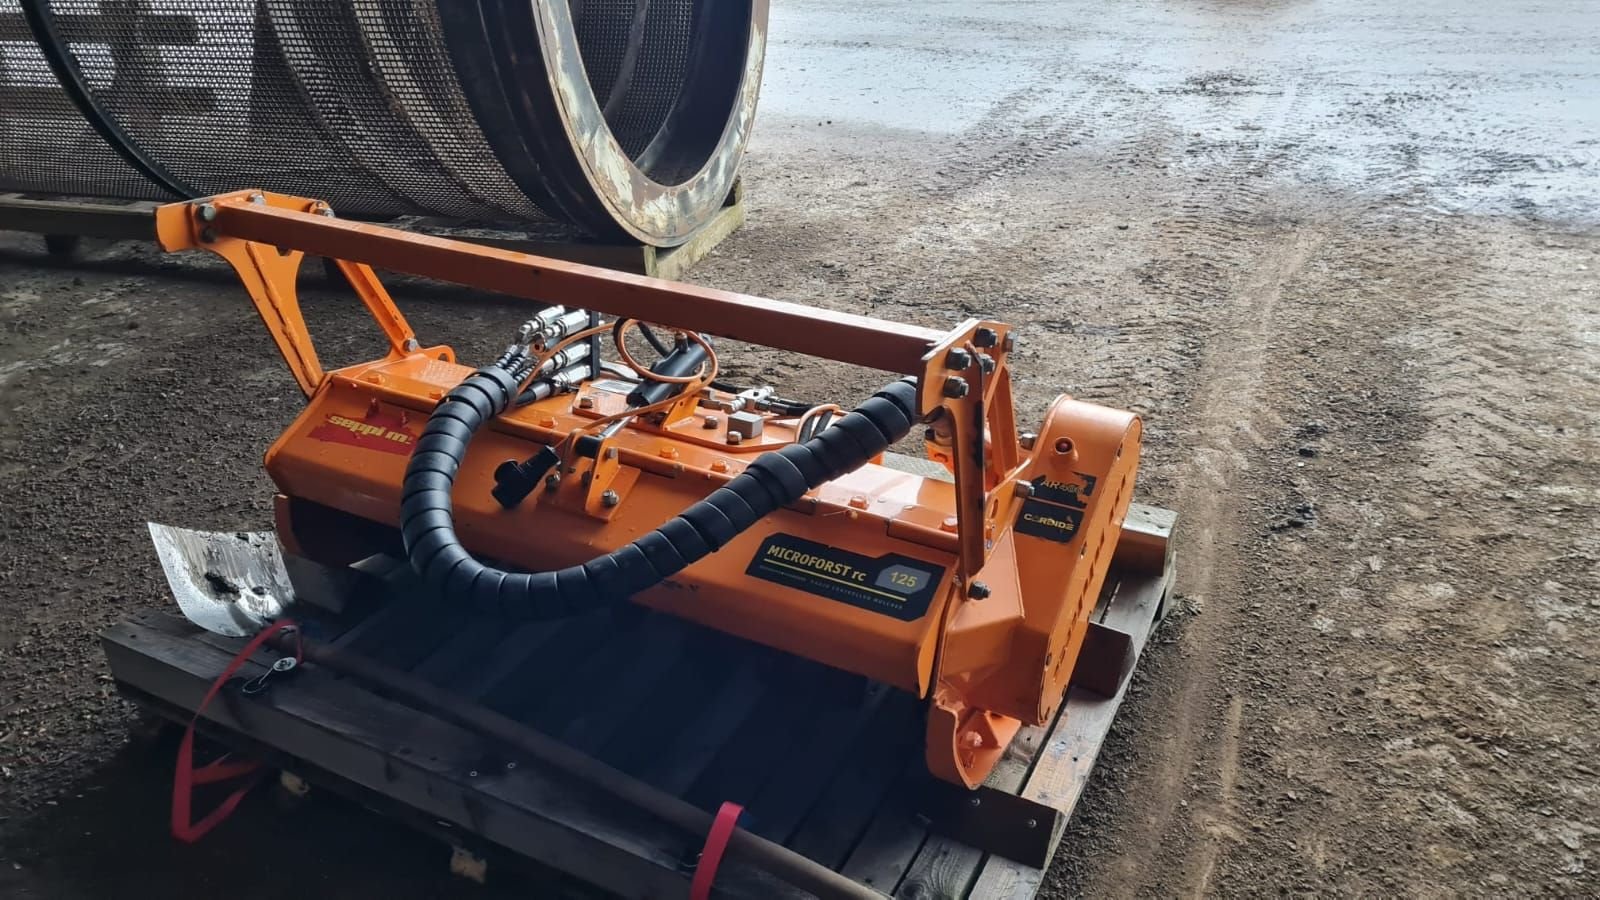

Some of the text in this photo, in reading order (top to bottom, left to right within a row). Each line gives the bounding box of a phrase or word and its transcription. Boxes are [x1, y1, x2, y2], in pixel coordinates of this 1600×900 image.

[328, 415, 387, 436] seppi
[767, 545, 853, 576] MICROFORST
[851, 571, 867, 582] rc
[891, 571, 918, 588] 125
